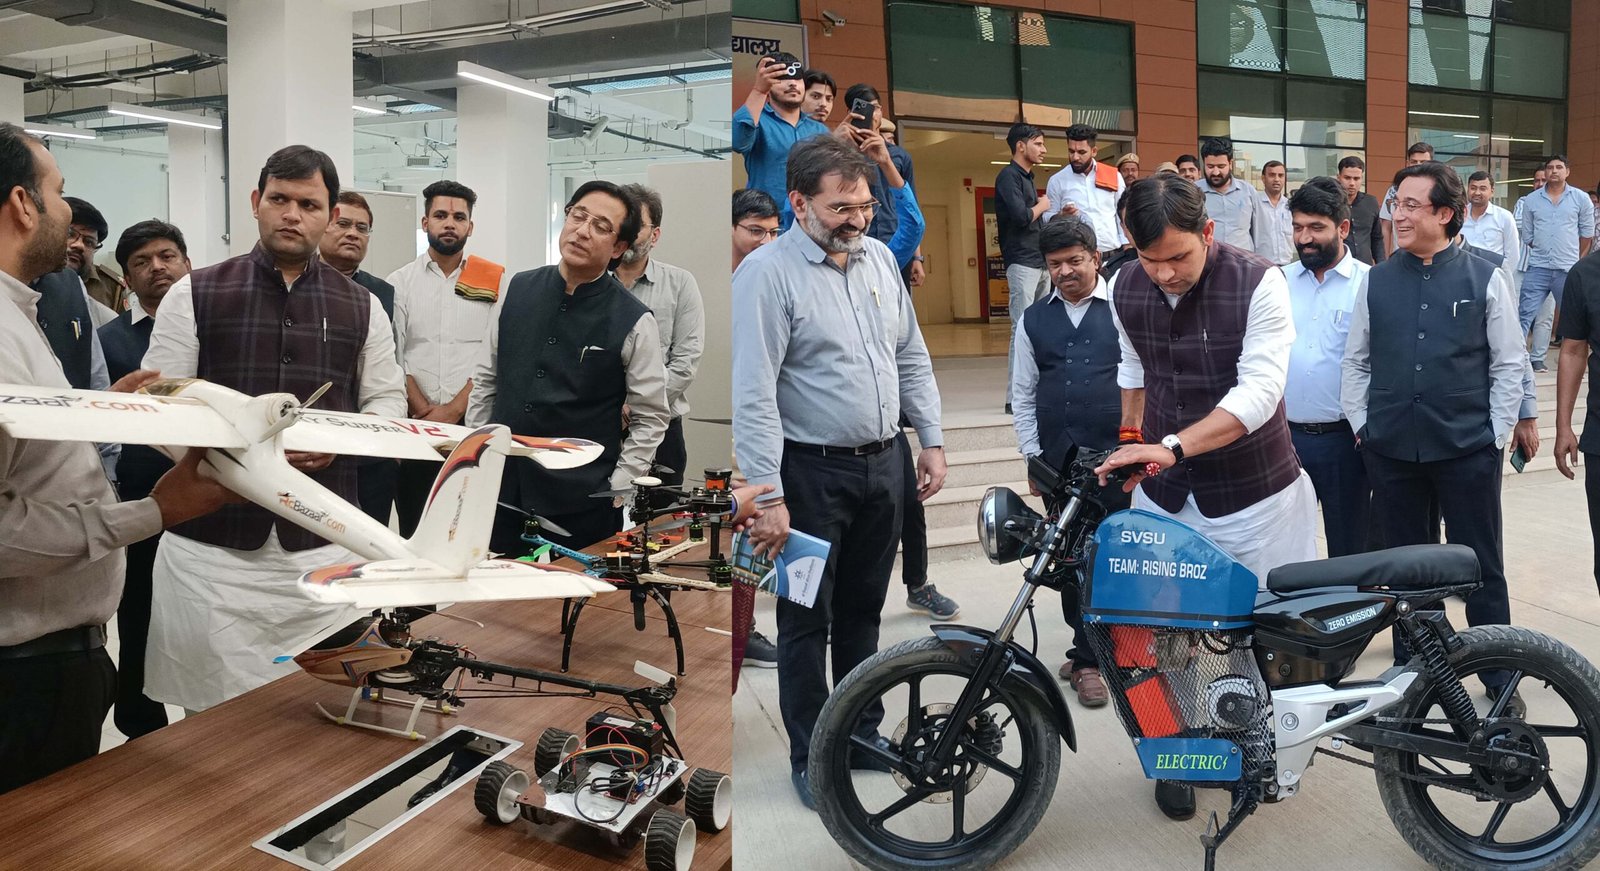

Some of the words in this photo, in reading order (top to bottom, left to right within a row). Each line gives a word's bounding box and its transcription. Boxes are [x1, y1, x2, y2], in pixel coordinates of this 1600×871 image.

[388, 420, 449, 438] V2
[1120, 530, 1166, 545] SVSU
[1108, 557, 1140, 575] TEAM:
[1142, 560, 1177, 577] RISING
[1179, 563, 1208, 580] BROZ
[1328, 617, 1346, 631] ZERO
[1345, 607, 1377, 625] EMISSION
[1155, 754, 1223, 770] ELECTRIC
